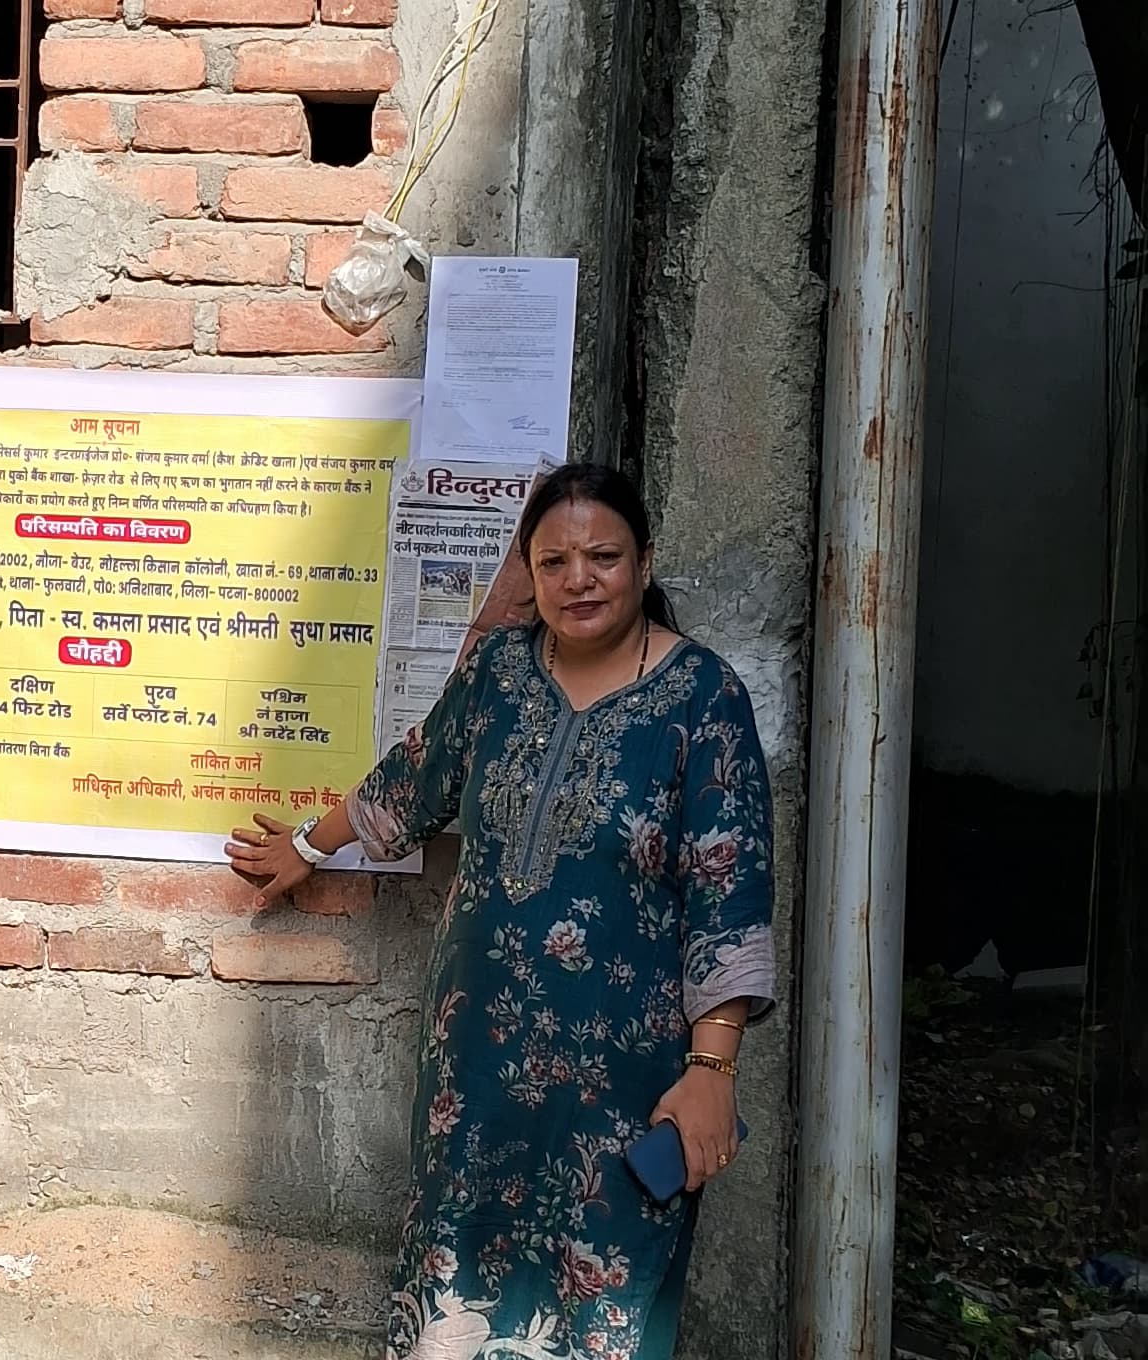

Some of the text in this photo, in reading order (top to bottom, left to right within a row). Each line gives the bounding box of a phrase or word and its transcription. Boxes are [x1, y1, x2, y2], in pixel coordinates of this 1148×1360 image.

[71, 419, 140, 440] आम सूचना
[24, 448, 48, 462] कुमार
[164, 453, 189, 467] कुमार
[192, 450, 210, 466] वर्मा
[272, 456, 296, 468] खाता
[320, 455, 347, 470] संजय
[349, 459, 376, 474] कुमार
[31, 467, 47, 481] बैंक
[108, 470, 125, 484] रोड
[130, 471, 138, 486] से
[142, 471, 161, 489] लिए
[164, 476, 177, 489] गए
[180, 477, 200, 488] ऋण
[203, 478, 216, 488] का
[219, 479, 253, 493] भुगतान
[256, 476, 274, 491] नहीं
[276, 477, 298, 491] करने
[301, 477, 311, 492] के
[314, 481, 341, 493] कारण
[344, 478, 362, 493] बैंक
[364, 480, 372, 494] ने
[427, 468, 532, 504] हिन्दुस्त
[26, 494, 38, 505] का
[41, 491, 65, 506] प्रयोग
[68, 493, 89, 507] करते
[92, 497, 105, 512] हुए
[108, 494, 129, 508] निम्न
[132, 495, 159, 510] वर्णित
[210, 501, 224, 512] का
[227, 499, 270, 515] अधिग्रहण
[274, 500, 298, 516] किया
[20, 518, 185, 540] परिसम्पति का विवरण
[394, 538, 500, 558] दर्ज मुकदमे वापस होंगे
[100, 554, 141, 572] मोहल्ला
[143, 555, 180, 574] किसान
[185, 557, 230, 579] कॉलोनी,
[236, 563, 263, 579] खाता
[364, 568, 378, 582] 33
[9, 600, 45, 628] पिता
[61, 610, 86, 630] स्व.
[92, 612, 143, 633] कमला
[148, 615, 192, 636] प्रसाद
[196, 611, 221, 641] एवं
[226, 611, 279, 640] श्रीमती
[290, 621, 325, 647] सुधा
[329, 622, 374, 645] प्रसाद
[10, 675, 55, 694] दक्षिण
[260, 688, 307, 704] पश्चिम
[12, 698, 44, 716] फिट
[48, 700, 72, 718] रोड
[102, 703, 131, 721] सर्वे
[132, 705, 170, 723] प्लॉट
[197, 712, 217, 727] 74
[238, 723, 258, 738] श्री
[299, 726, 331, 744] सिंह
[29, 741, 51, 757] बिना
[53, 743, 71, 758] बैंक
[191, 750, 264, 772] ताकित जानें
[72, 774, 123, 799] प्राधिकृत
[127, 777, 186, 801] अधिकारी,
[229, 783, 285, 806] कार्यालय,
[289, 786, 316, 810] यूको
